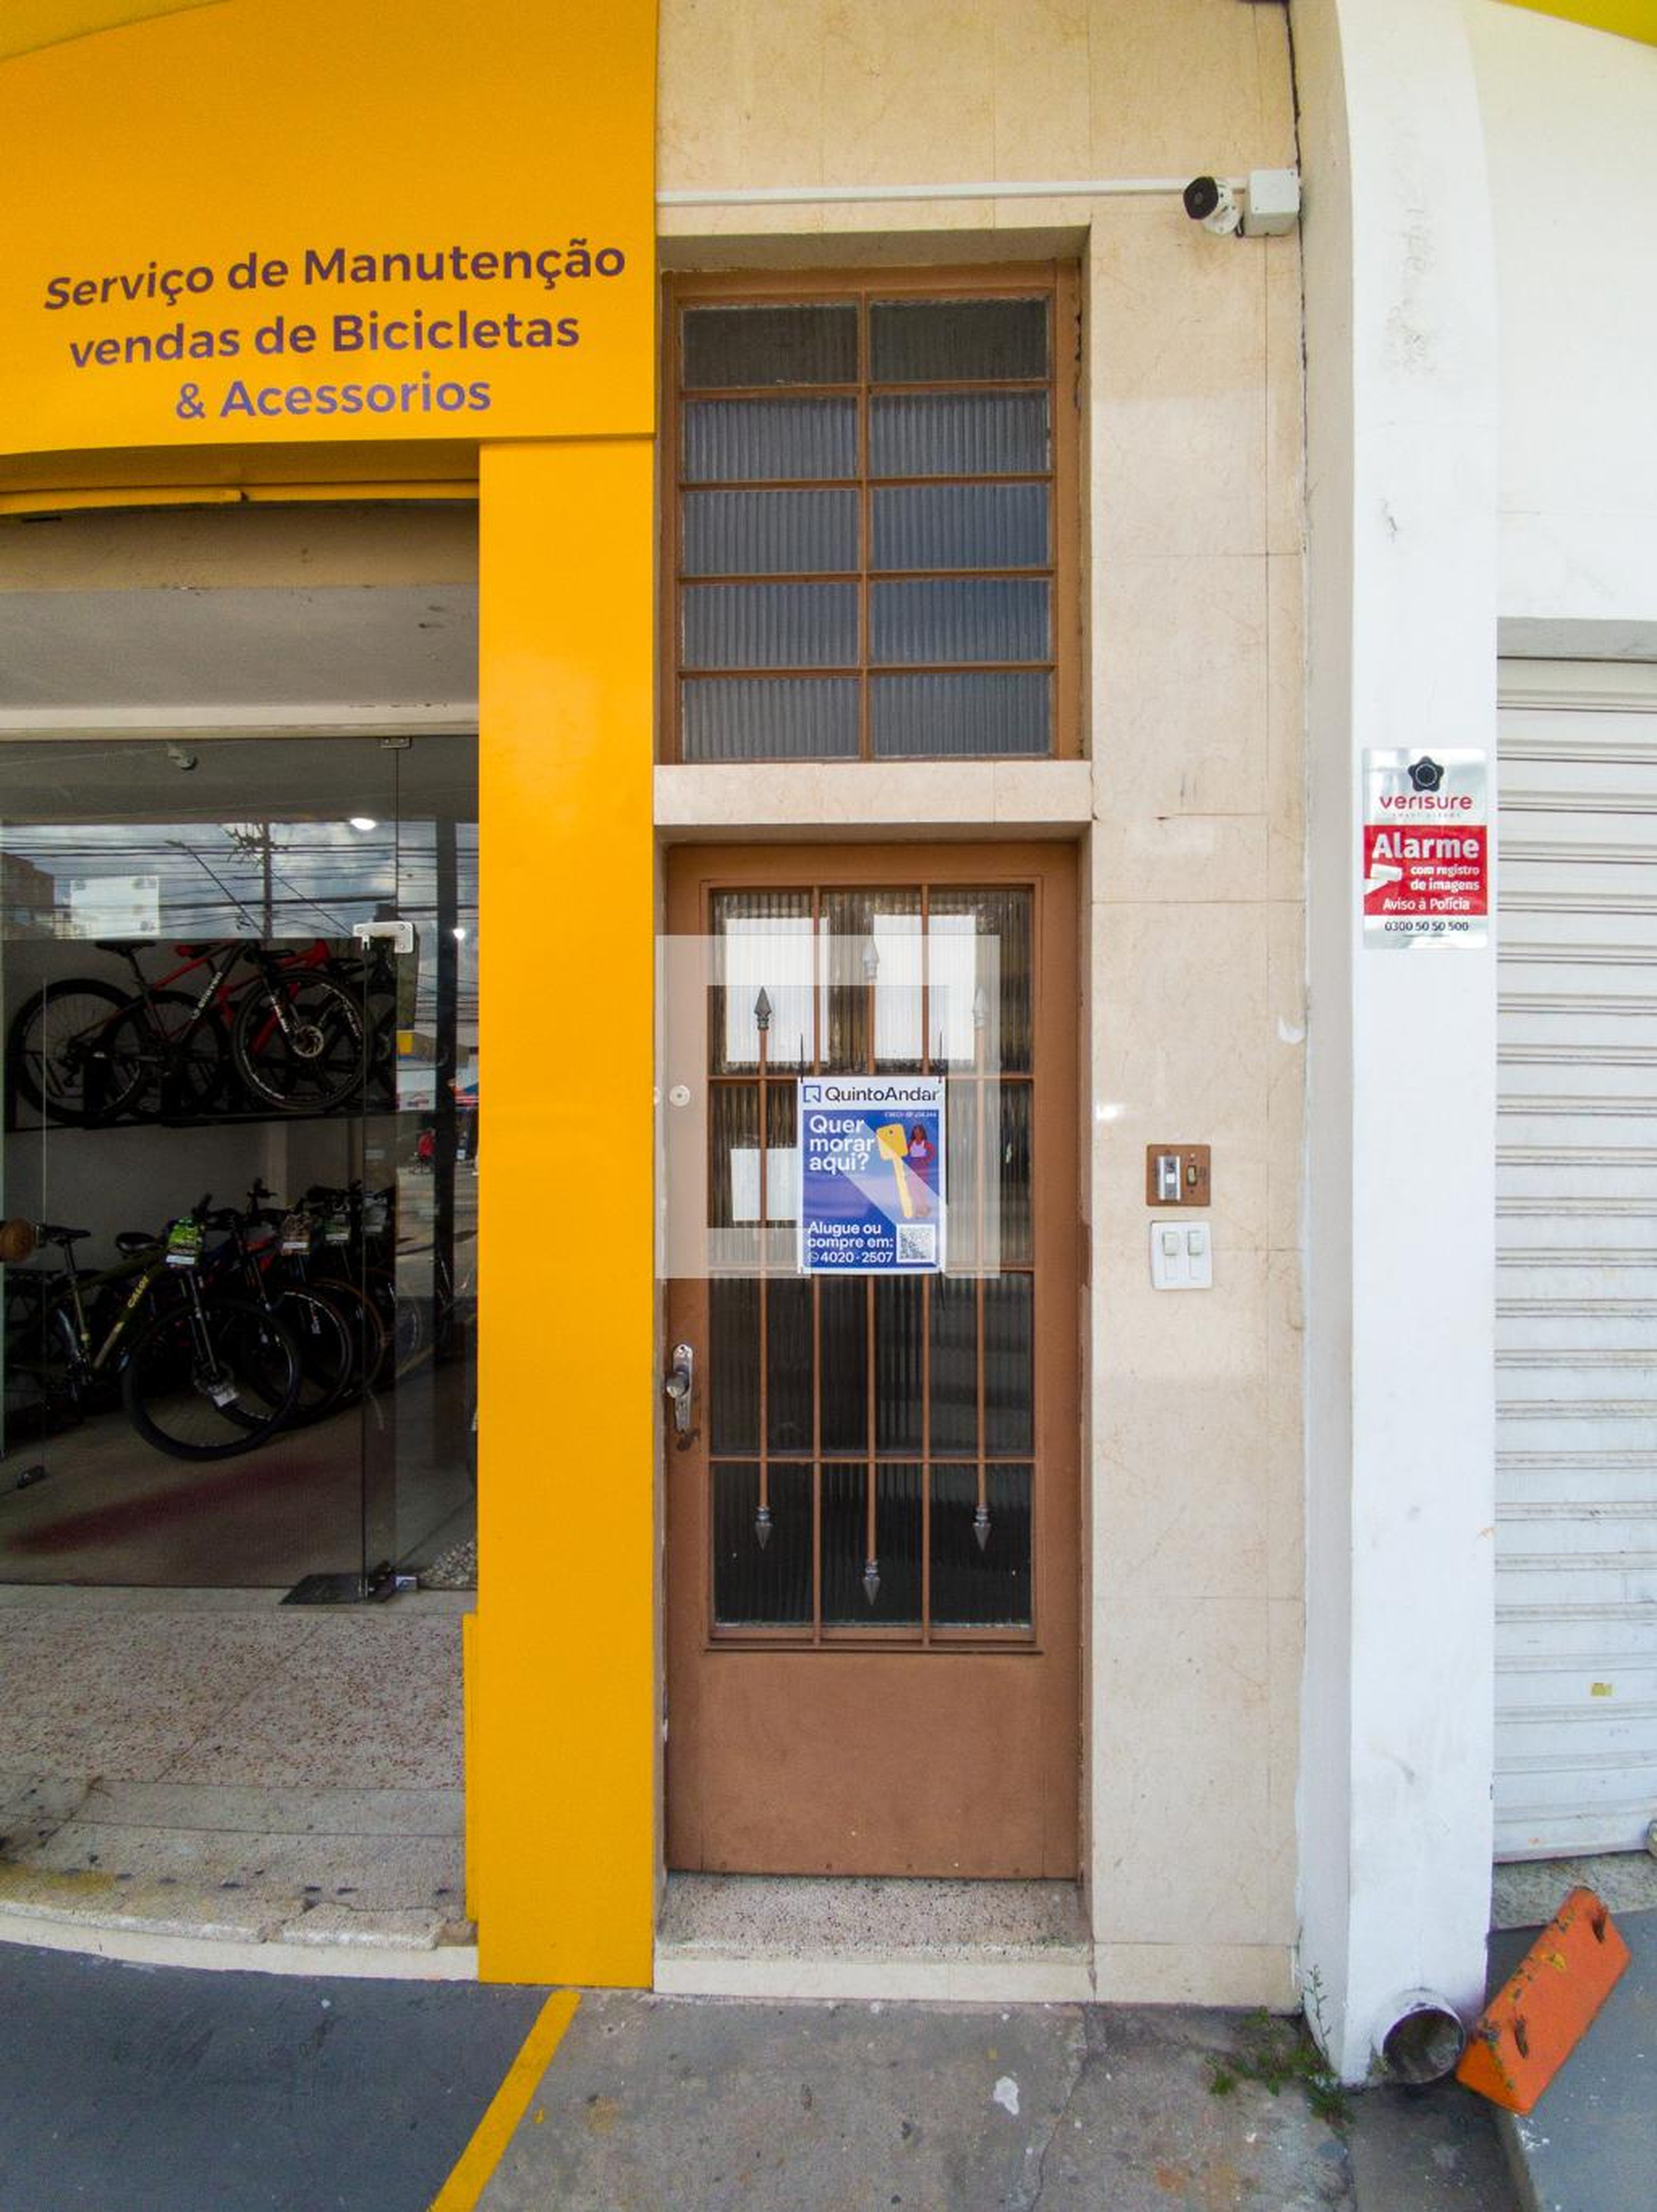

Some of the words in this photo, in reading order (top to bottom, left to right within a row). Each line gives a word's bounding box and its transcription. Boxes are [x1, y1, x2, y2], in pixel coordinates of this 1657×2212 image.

[44, 262, 214, 312] Serviço
[228, 252, 289, 290] de
[304, 238, 624, 290] Manutenção
[69, 323, 239, 368] vendas
[255, 317, 316, 354] de
[333, 310, 580, 353] Bicicletas
[176, 383, 206, 419] &
[220, 371, 491, 418] Acessorios
[1380, 795, 1472, 809] verisure
[1372, 832, 1480, 859] Alarme
[1411, 865, 1434, 875] com
[1437, 864, 1480, 879] registro
[1411, 878, 1425, 891] de
[1429, 878, 1480, 892] imagens
[1383, 898, 1415, 910] Aviso
[1430, 897, 1470, 910] Polícia
[1385, 921, 1413, 931] 0300
[1416, 921, 1429, 931] 50
[1432, 921, 1445, 931] 50
[1448, 921, 1468, 931] 500
[825, 1087, 938, 1102] QuintoAndar
[810, 1115, 865, 1134] Quer
[810, 1138, 875, 1152] morar
[809, 1153, 869, 1174] aqui?
[808, 1222, 860, 1238] Alugue
[863, 1224, 881, 1234] ou
[808, 1238, 863, 1253] compre
[867, 1238, 894, 1248] em:
